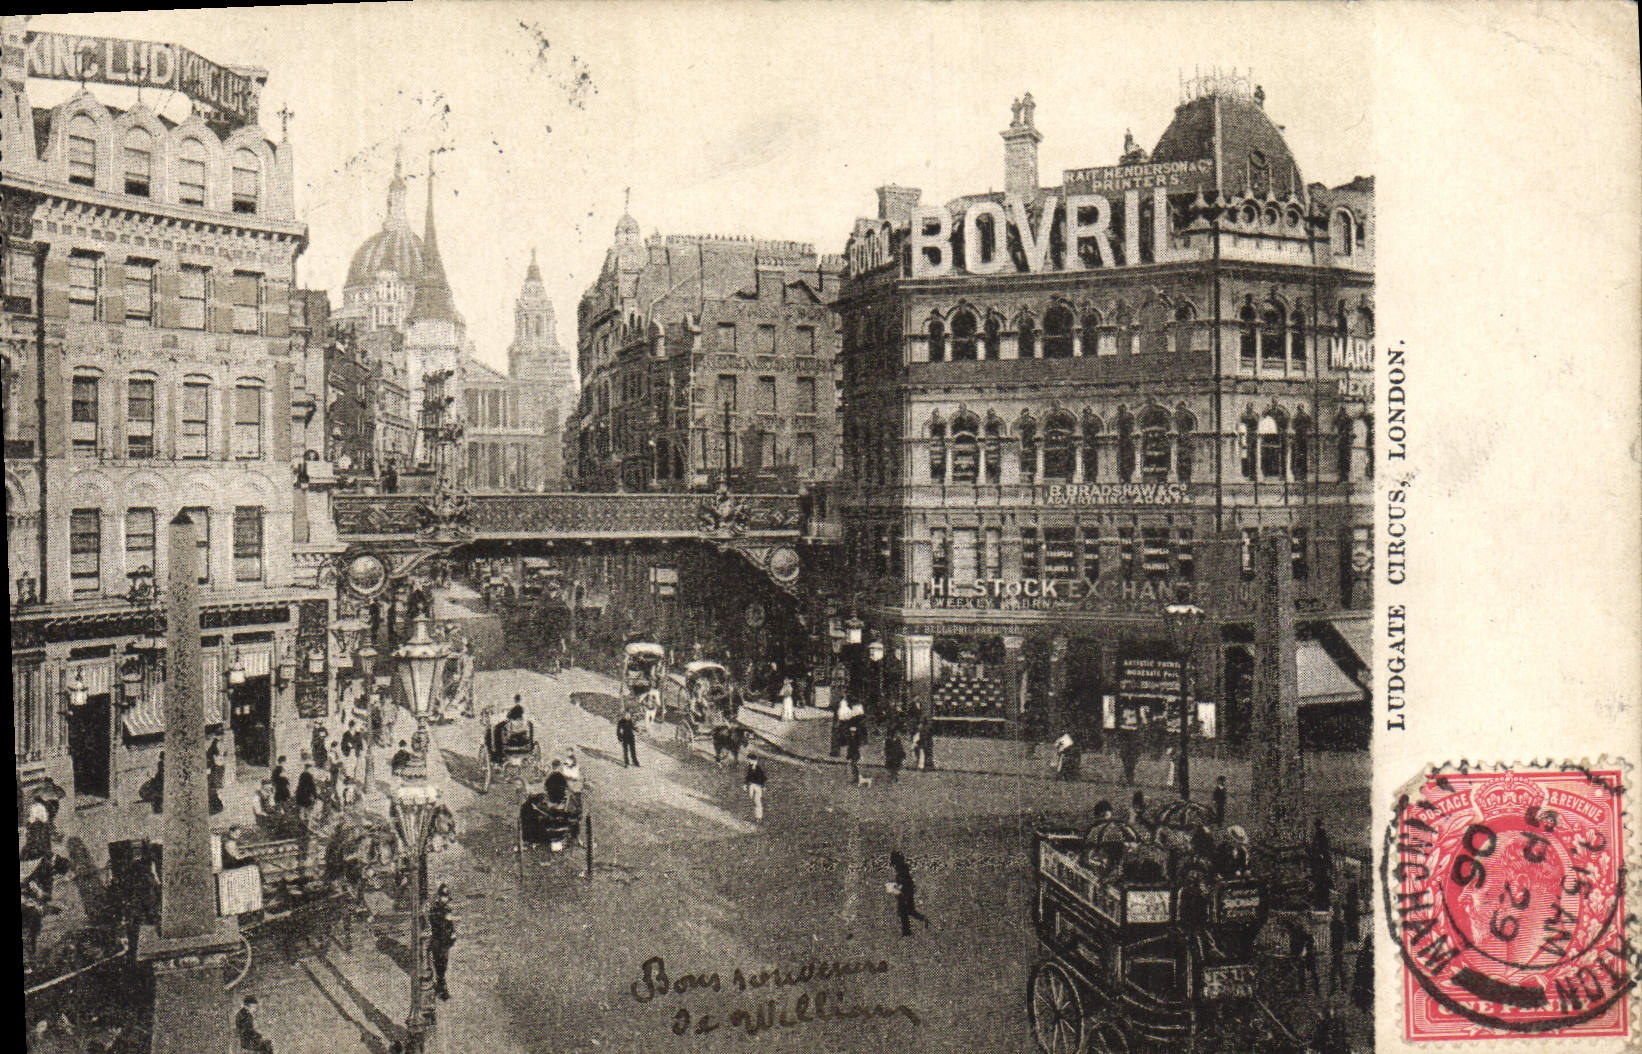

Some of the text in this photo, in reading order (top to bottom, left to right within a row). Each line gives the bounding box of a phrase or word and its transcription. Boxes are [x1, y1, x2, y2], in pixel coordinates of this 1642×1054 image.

[27, 33, 175, 84] KING LUD
[911, 188, 1202, 279] BOVRIL
[973, 577, 1058, 598] STOCK
[1417, 792, 1470, 823] POSTAGE
